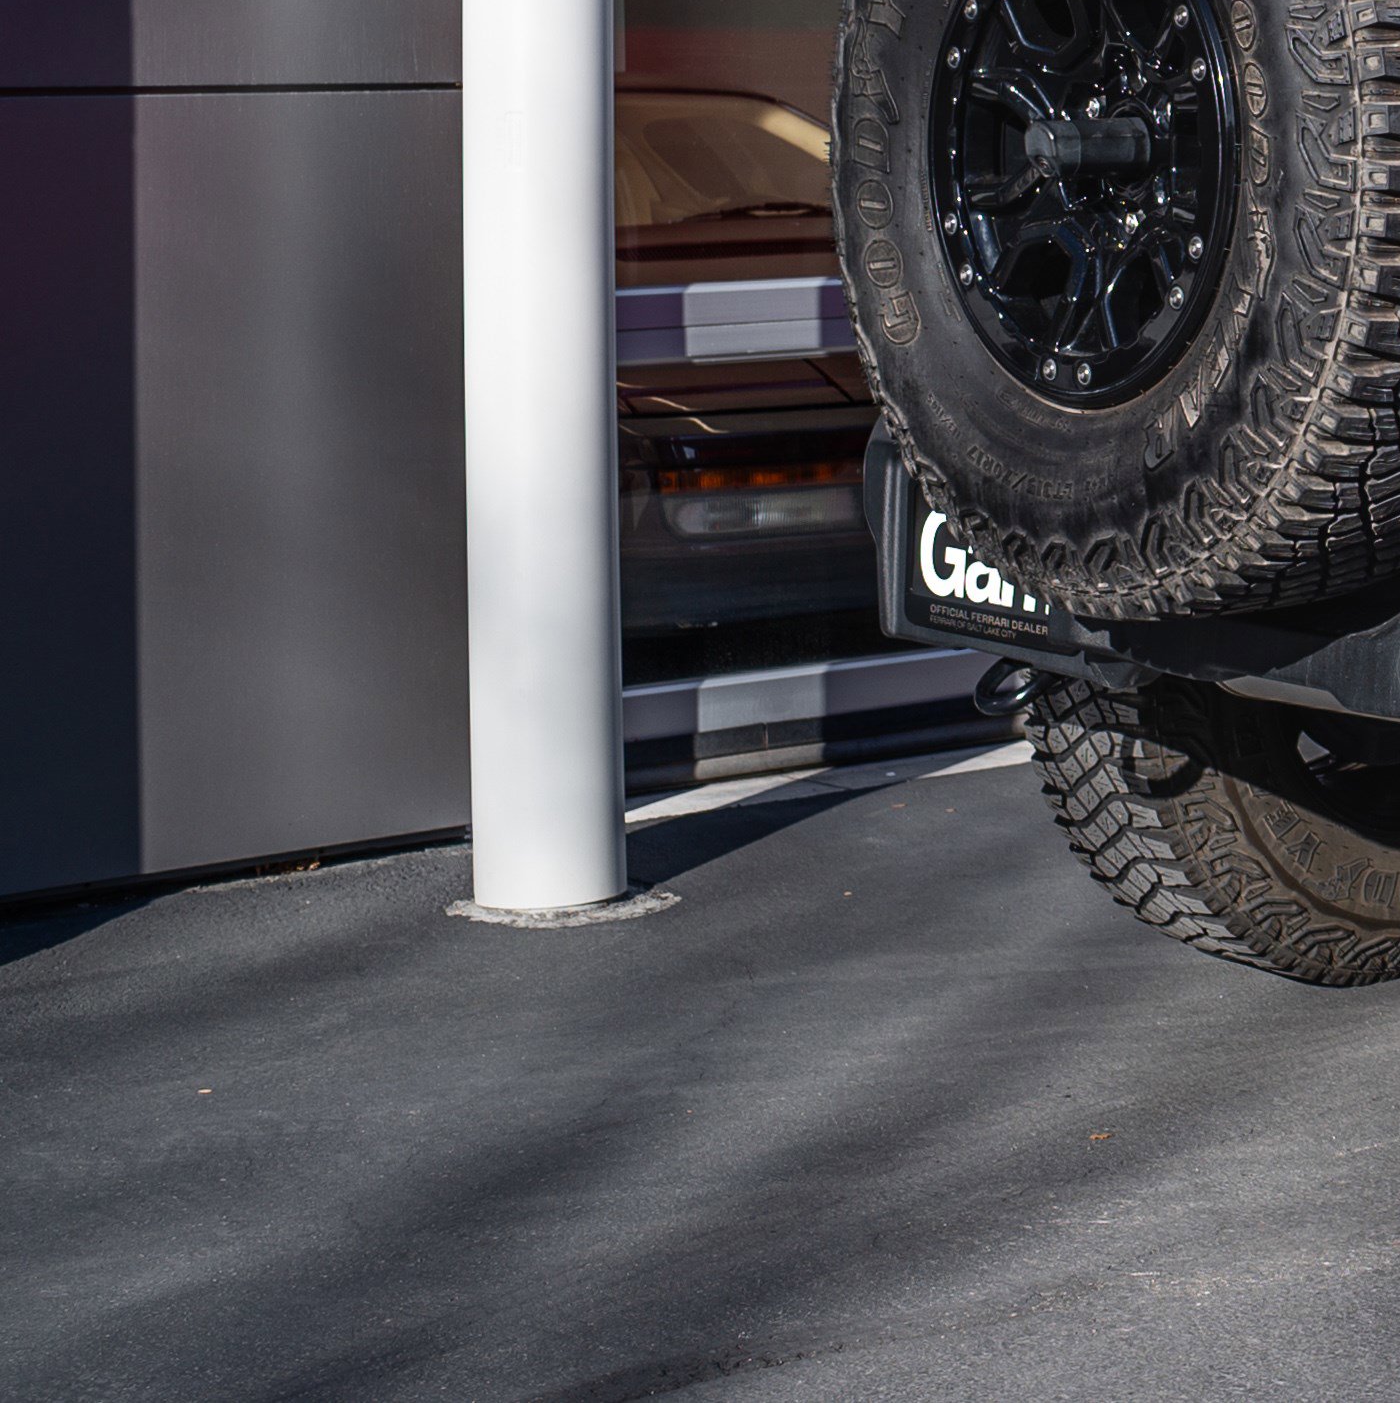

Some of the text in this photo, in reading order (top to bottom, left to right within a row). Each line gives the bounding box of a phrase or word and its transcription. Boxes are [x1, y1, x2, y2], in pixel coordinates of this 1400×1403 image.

[929, 603, 1049, 636] OFFICIAL FERRARI DEALER
[929, 614, 956, 627] FERRARI
[983, 625, 1000, 636] LAKE
[1000, 628, 1017, 639] CITY
